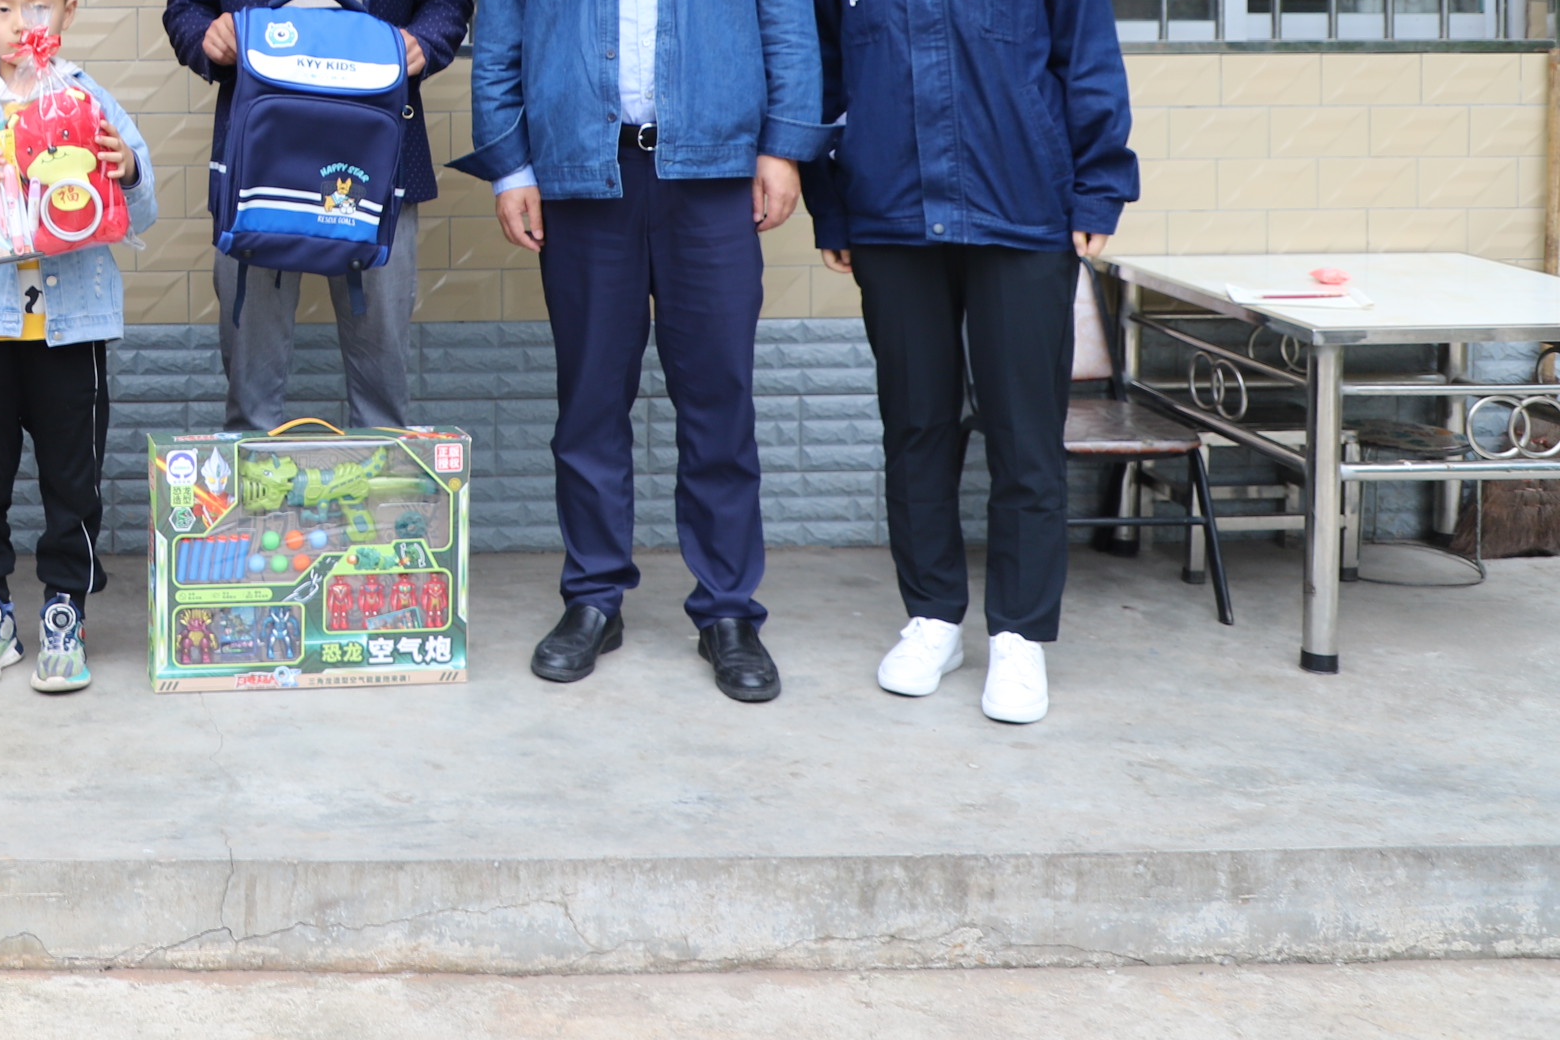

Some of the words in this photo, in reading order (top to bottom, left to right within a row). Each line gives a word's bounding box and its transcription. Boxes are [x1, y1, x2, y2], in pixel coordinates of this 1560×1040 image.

[297, 57, 322, 69] KYY
[326, 60, 357, 72] KIDS
[320, 162, 348, 177] HAPPY
[347, 165, 370, 183] STAR
[57, 185, 80, 205] 福
[321, 642, 363, 663] 恐龙
[367, 635, 452, 664] 空气炮
